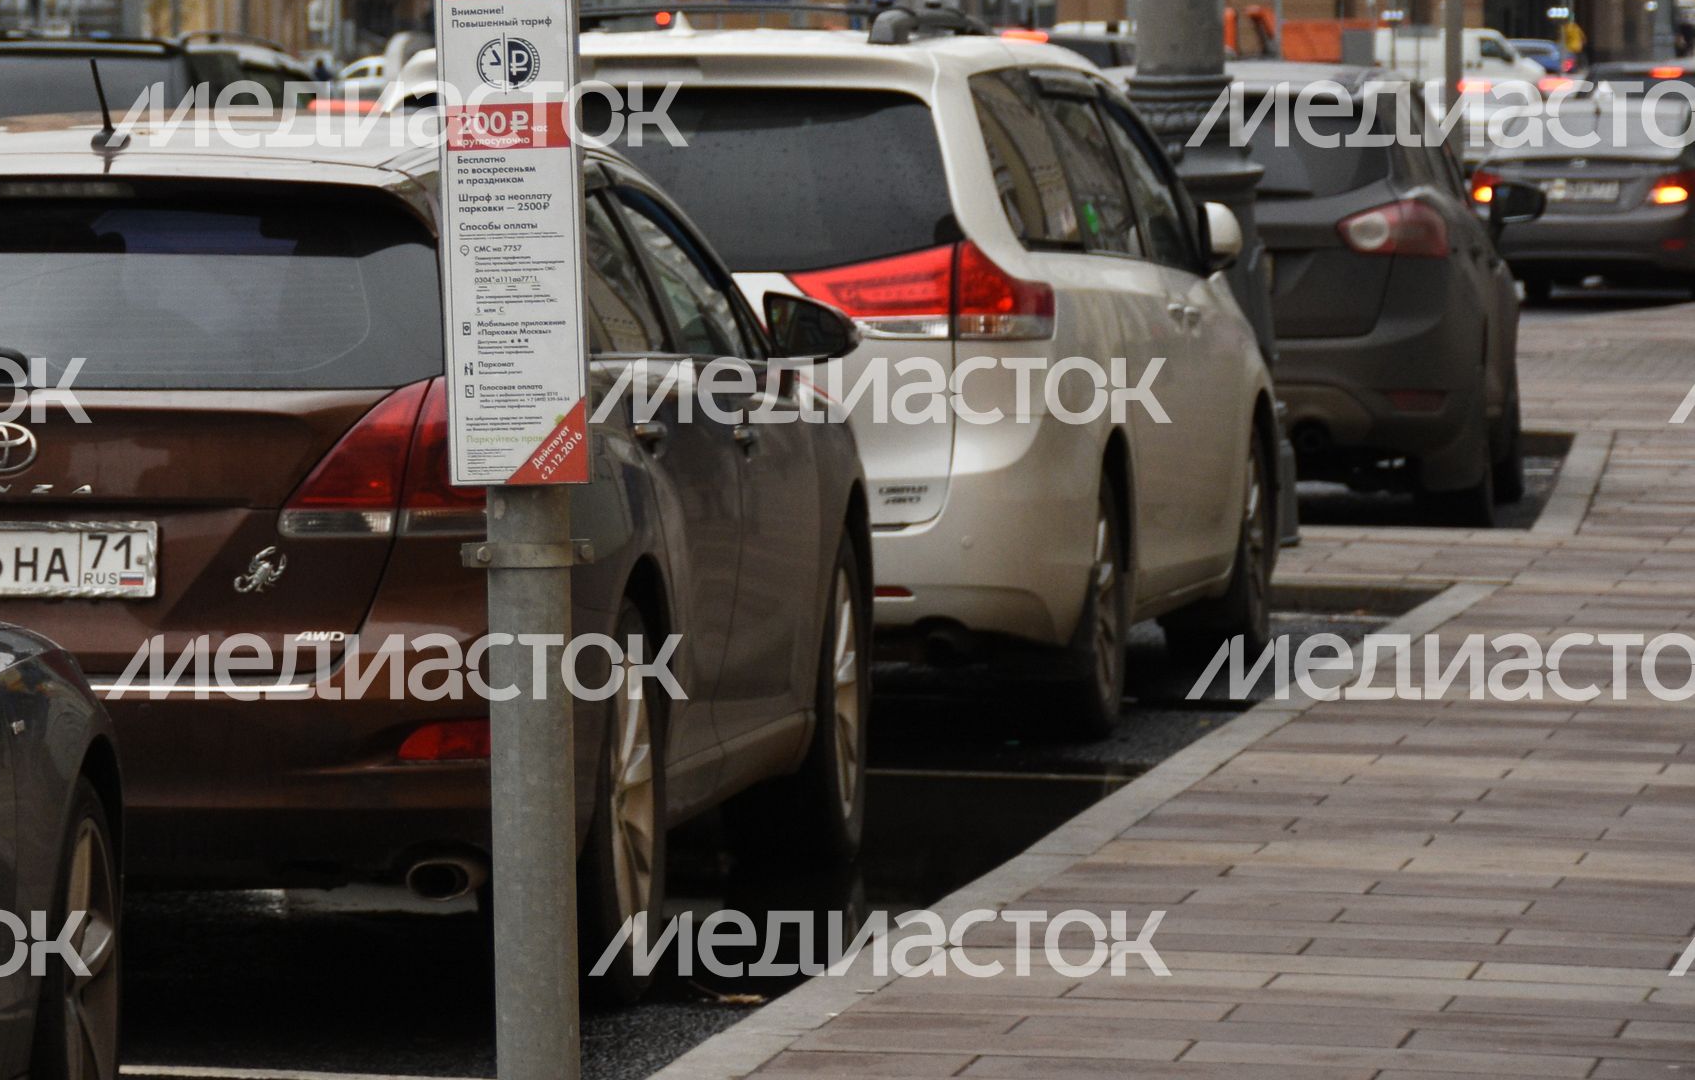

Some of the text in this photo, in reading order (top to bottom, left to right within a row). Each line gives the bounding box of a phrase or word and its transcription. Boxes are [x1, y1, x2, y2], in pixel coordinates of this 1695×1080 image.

[451, 6, 504, 16] Внимание!
[451, 17, 552, 29] Повышенный тариф
[457, 156, 506, 164] Бесплатно
[458, 166, 536, 176] по воскресеньям
[466, 176, 524, 187] праздникам
[458, 193, 492, 204] Штраф
[508, 193, 552, 202] неоплату
[459, 205, 504, 215] парковки
[459, 222, 501, 231] Способы
[477, 319, 566, 328] Мобильное приложение
[478, 361, 514, 369] Паркомат
[532, 425, 570, 469] Действует
[544, 432, 583, 474] 2.12.2016
[88, 535, 131, 570] 71
[84, 573, 117, 585] RUS
[295, 631, 345, 642] AWD
